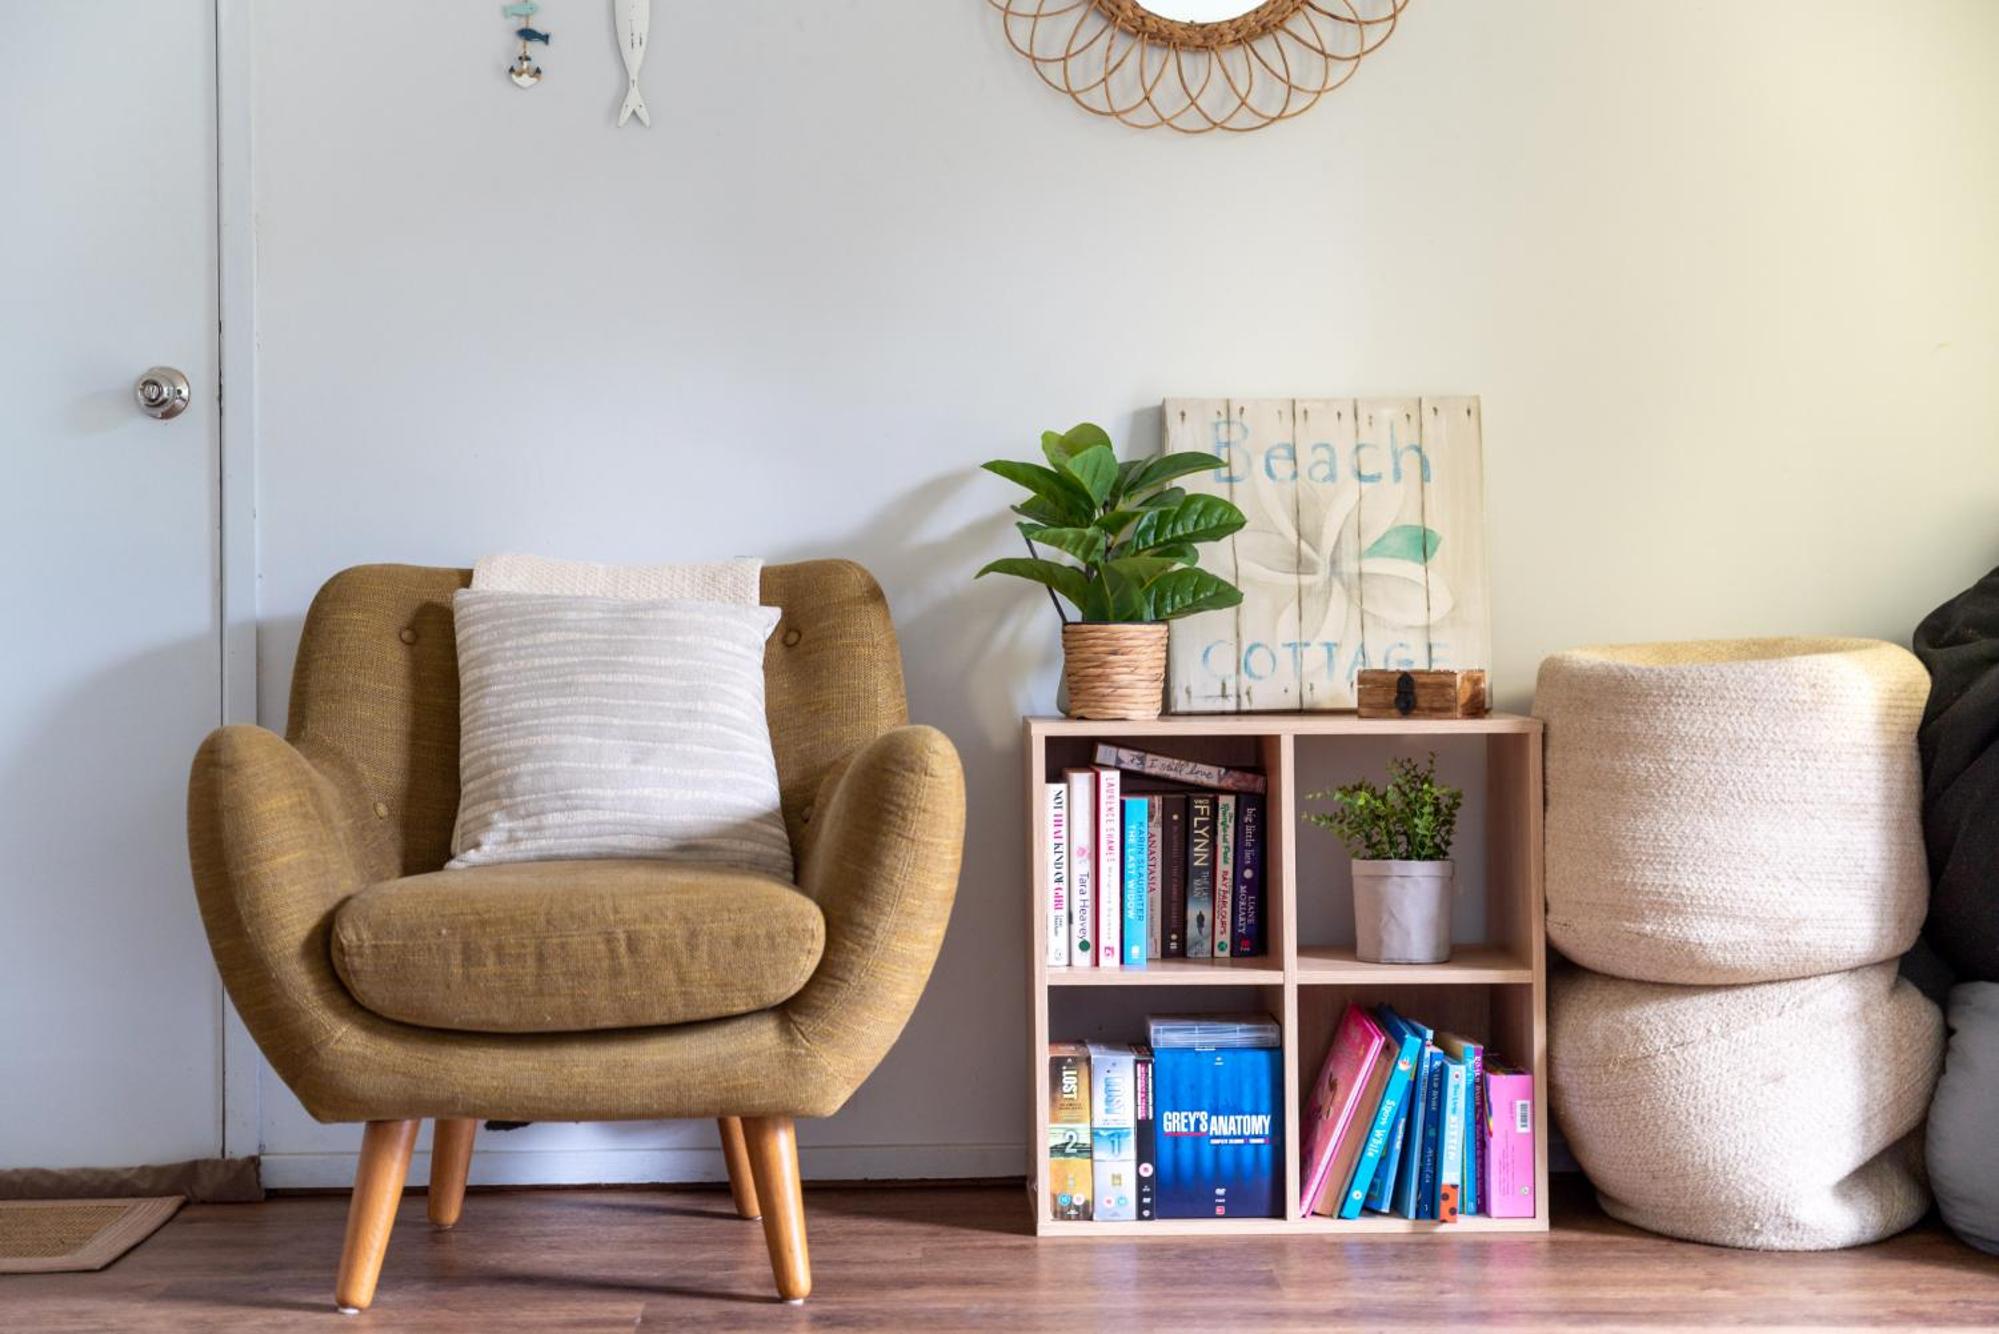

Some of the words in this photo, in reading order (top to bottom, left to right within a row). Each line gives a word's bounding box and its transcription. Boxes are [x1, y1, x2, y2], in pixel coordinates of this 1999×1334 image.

[1210, 420, 1431, 484] Beach
[1053, 790, 1064, 810] NOT
[1053, 813, 1064, 840] THAT
[1243, 807, 1256, 823] big
[1193, 805, 1210, 867] FLYNN
[1245, 824, 1256, 847] little
[1053, 842, 1064, 870] KIND
[1127, 848, 1136, 876] LAST
[1147, 832, 1157, 894] ANASTASIA
[1244, 849, 1255, 864] lies
[1053, 872, 1064, 885] OF
[1079, 872, 1089, 896] Tara
[1136, 859, 1144, 922] SLAUGHTER
[1193, 879, 1202, 897] MAN
[1053, 887, 1064, 911] GIRL
[1127, 879, 1136, 920] WIDOW
[1238, 885, 1247, 935] MORIARTY
[1247, 896, 1255, 925] LIANE
[1077, 899, 1089, 941] Heavey
[1063, 1070, 1077, 1099] LOST
[1104, 1076, 1125, 1115] LOST
[1163, 1111, 1208, 1133] GREY'S
[1209, 1115, 1271, 1136] ANATOMY
[1380, 1098, 1396, 1126] Snow
[1065, 1130, 1078, 1154] 2
[1111, 1136, 1120, 1156] 1
[1366, 1129, 1386, 1157] White
